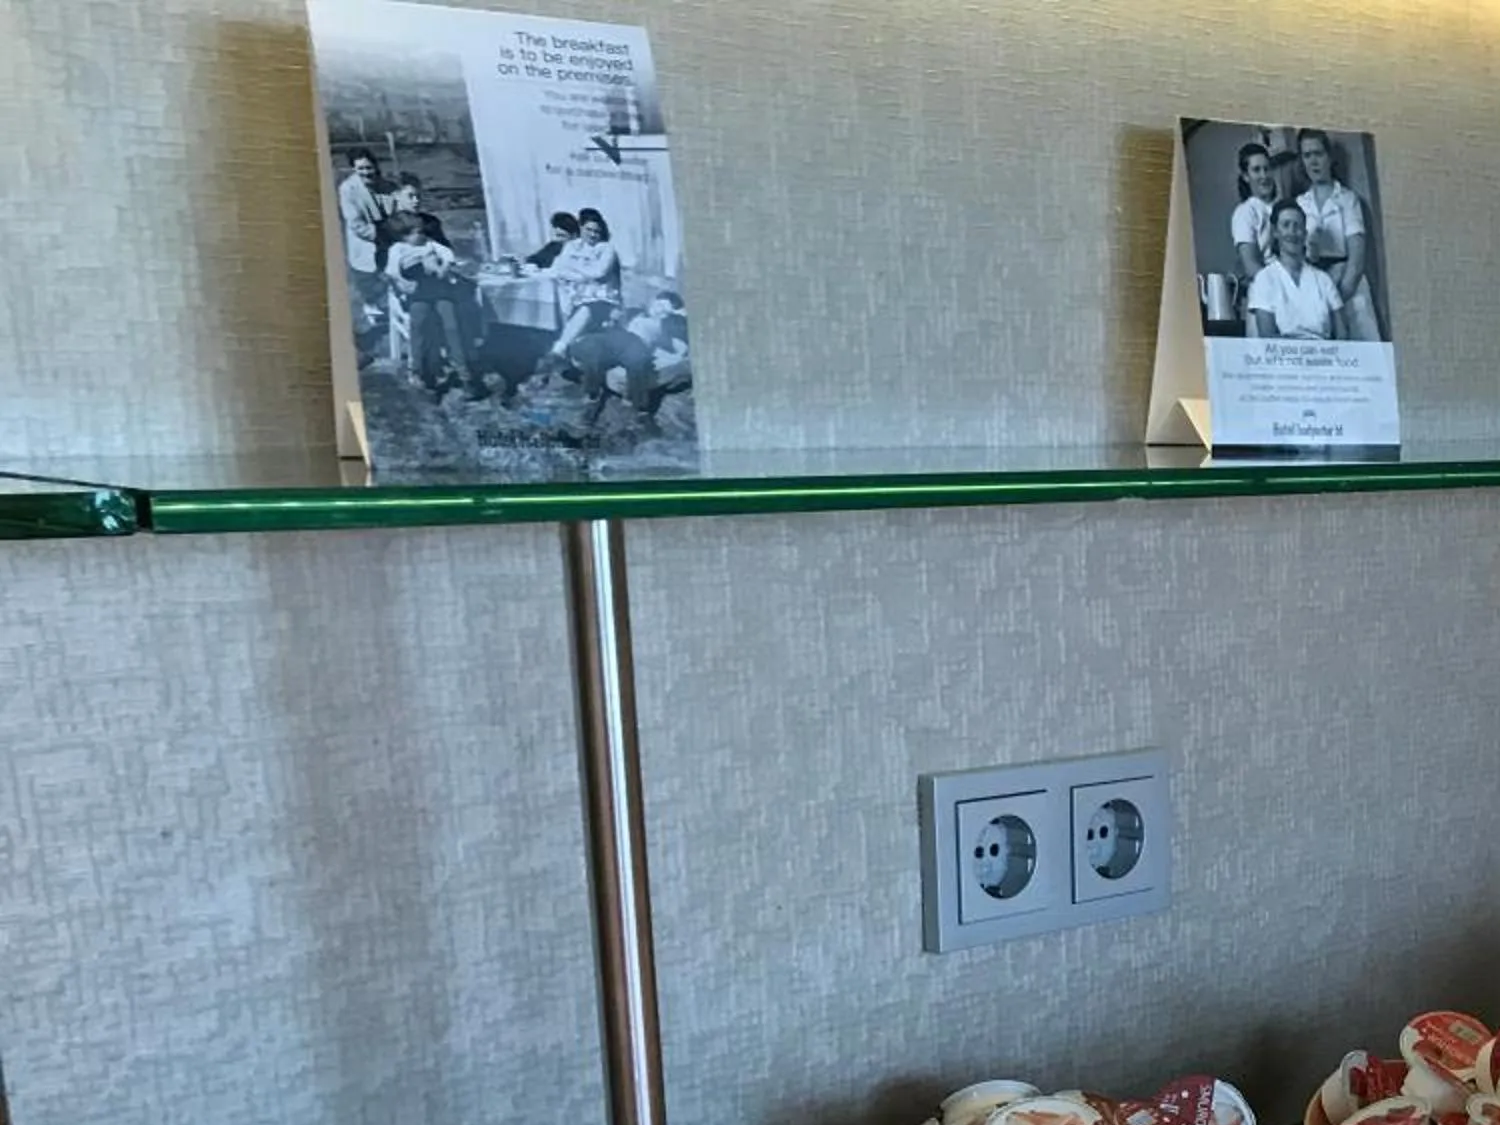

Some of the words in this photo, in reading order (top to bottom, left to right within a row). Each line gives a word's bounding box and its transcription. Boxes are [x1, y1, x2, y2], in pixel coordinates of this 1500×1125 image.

[514, 30, 547, 47] The
[551, 35, 629, 54] breakfast
[497, 63, 519, 76] on
[525, 64, 553, 79] the
[499, 46, 515, 60] is
[519, 47, 539, 62] to
[543, 50, 564, 65] be
[568, 54, 635, 72] enjoyed
